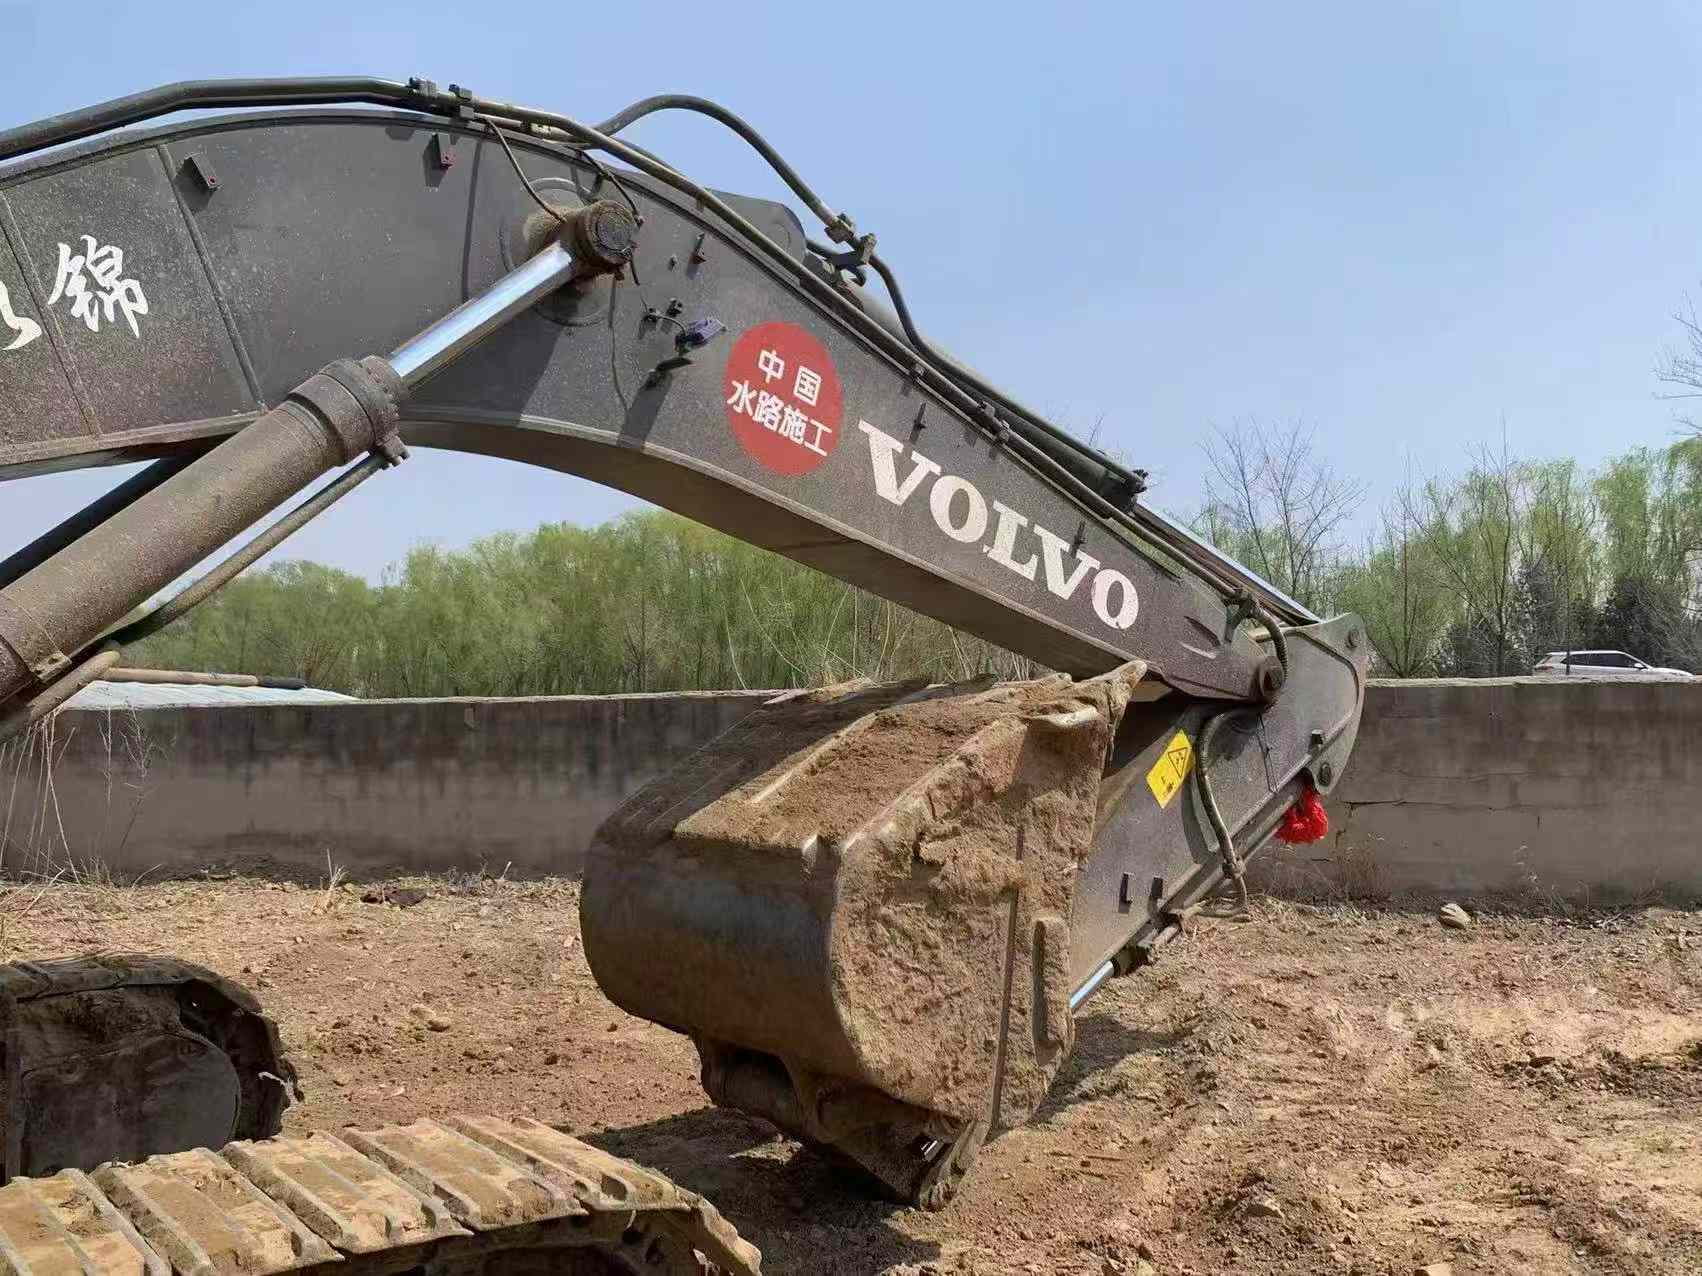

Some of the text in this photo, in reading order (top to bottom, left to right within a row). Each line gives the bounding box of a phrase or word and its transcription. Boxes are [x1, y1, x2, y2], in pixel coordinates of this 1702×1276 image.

[758, 350, 822, 406] 中国
[727, 380, 832, 456] 水路施工
[858, 419, 1139, 630] VOLVO
